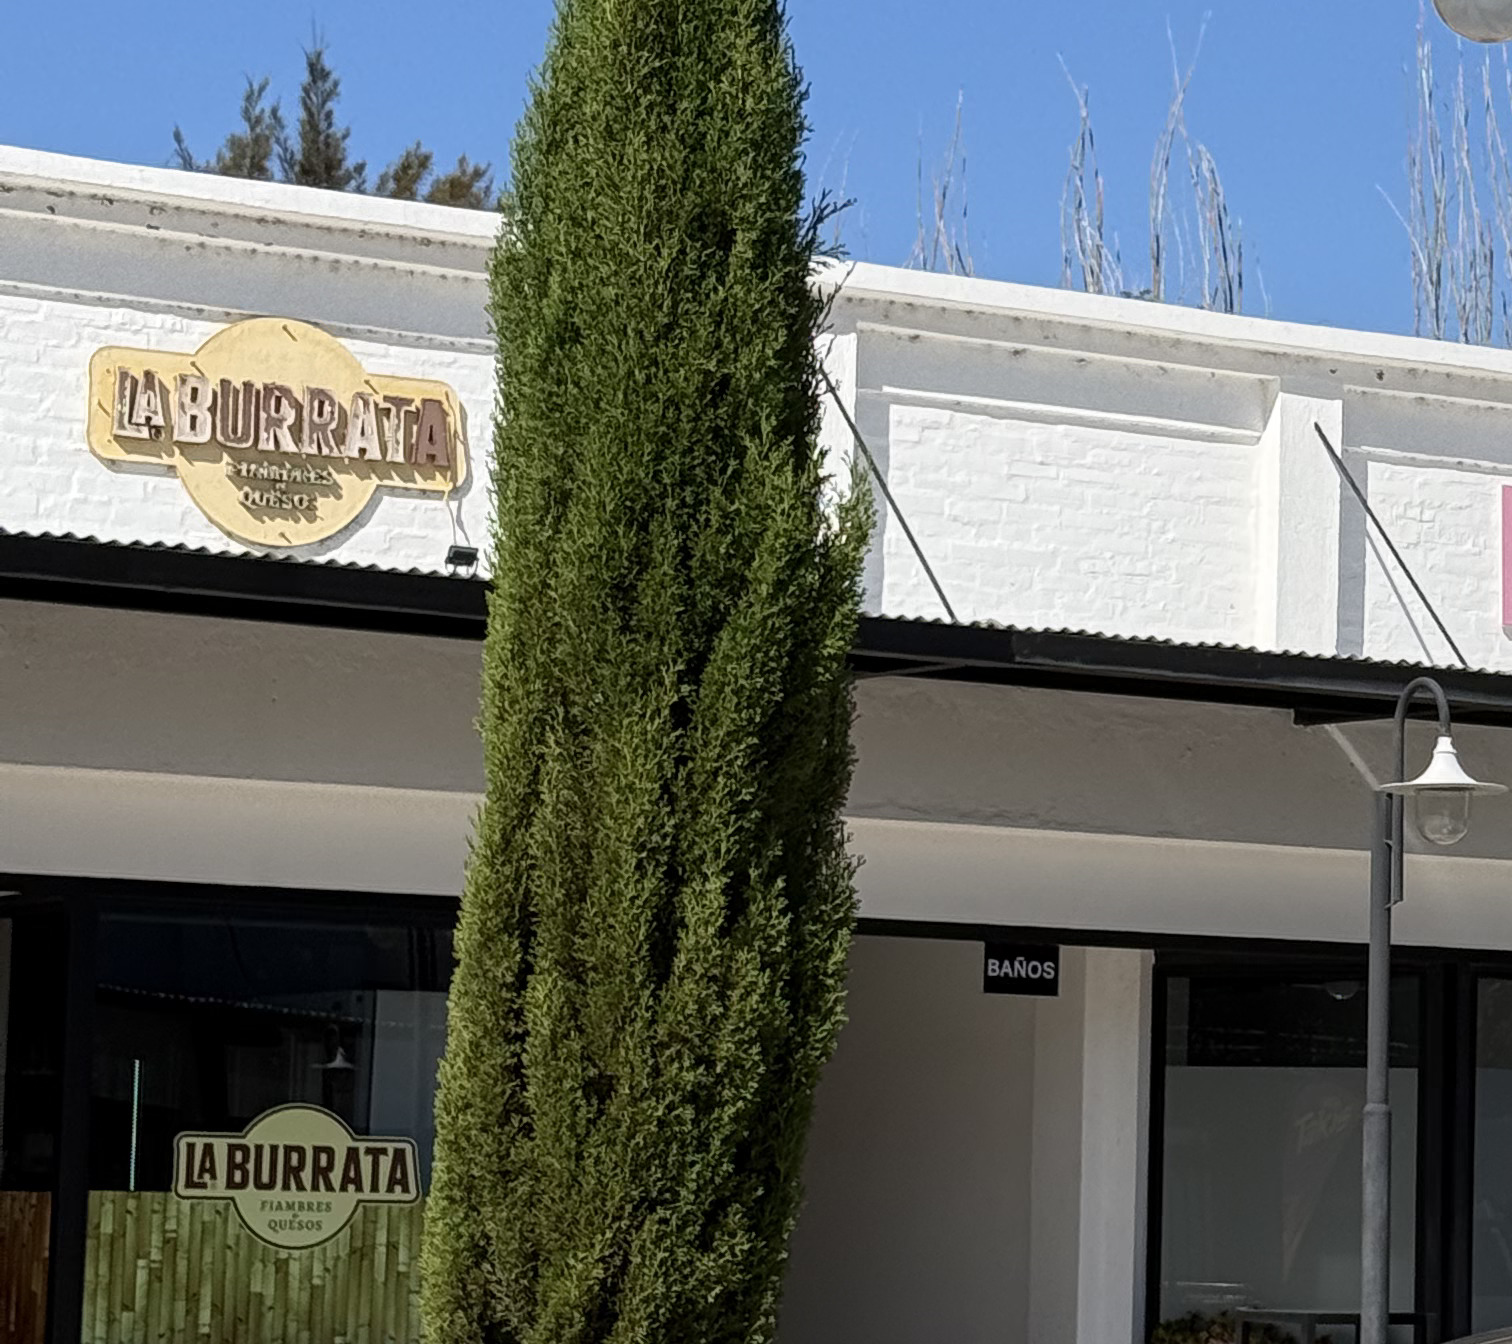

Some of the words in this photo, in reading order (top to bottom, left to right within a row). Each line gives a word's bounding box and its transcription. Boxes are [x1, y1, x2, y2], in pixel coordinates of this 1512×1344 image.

[113, 365, 166, 439] LA
[172, 372, 451, 467] BURRATA
[987, 956, 1055, 979] BAÑOS
[184, 1142, 218, 1189] LA
[225, 1142, 412, 1193] BURRATA
[259, 1199, 333, 1213] FIAMBRES
[267, 1219, 323, 1233] QUESOS
